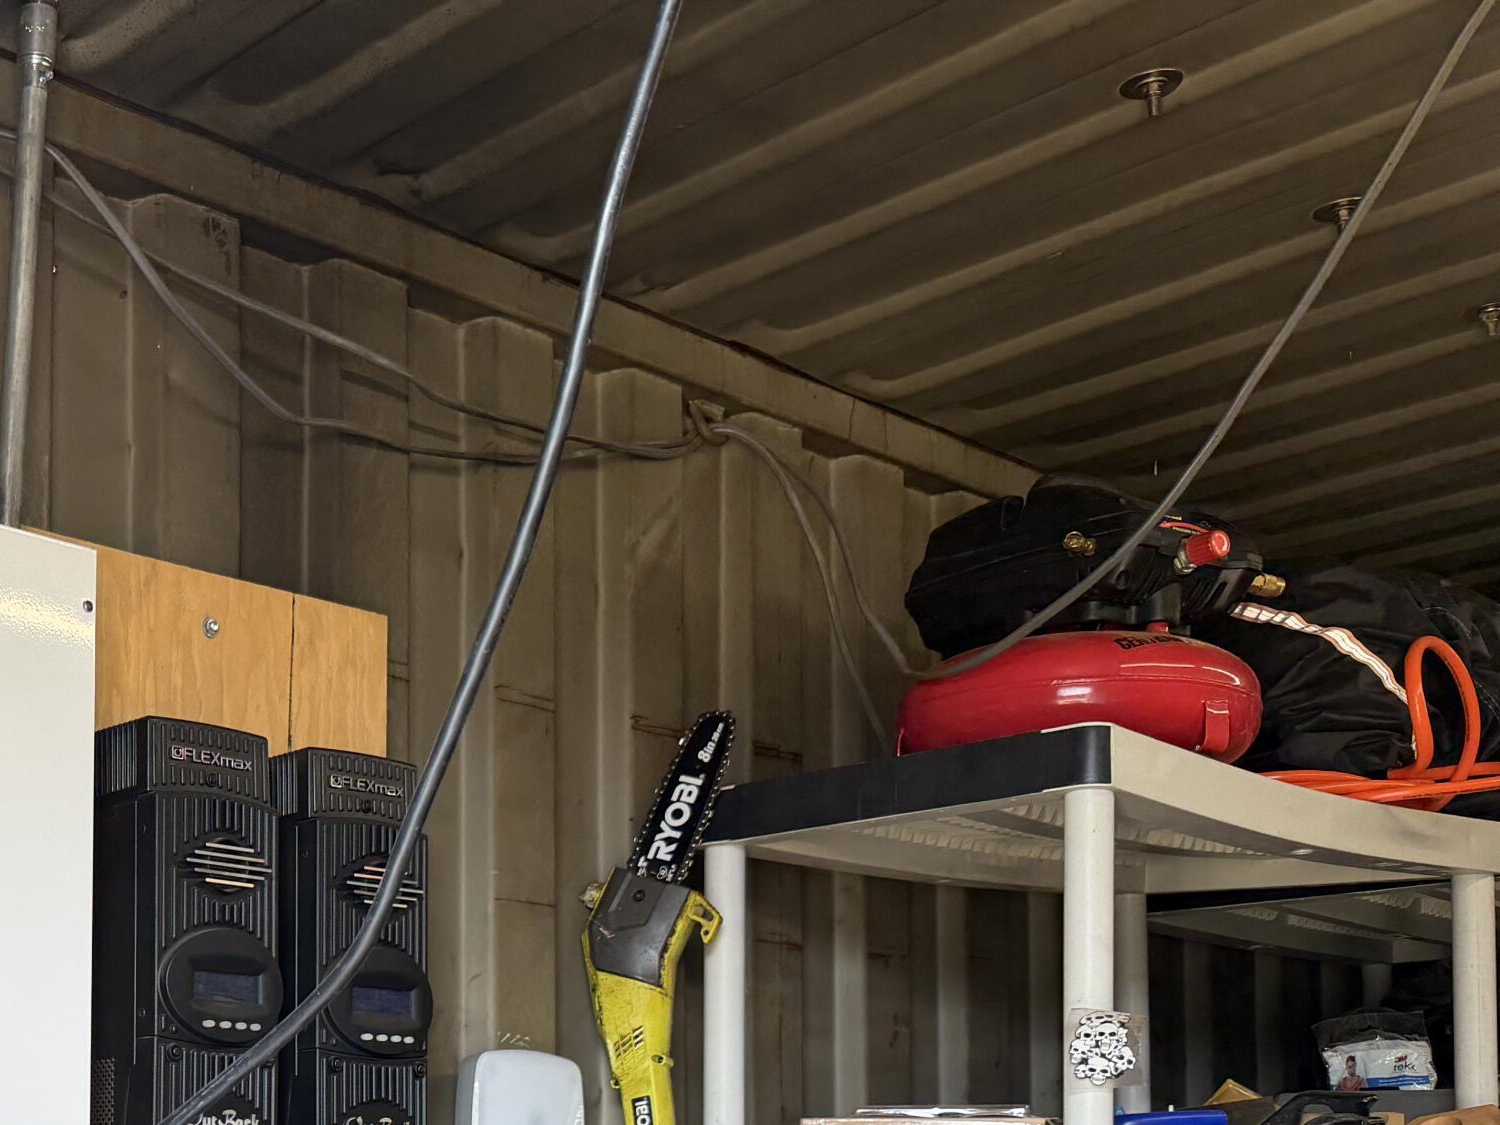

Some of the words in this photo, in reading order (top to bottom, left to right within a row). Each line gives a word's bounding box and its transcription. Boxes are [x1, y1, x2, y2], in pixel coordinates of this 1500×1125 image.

[184, 749, 252, 771] FLEXmax
[340, 776, 403, 797] FLEXmax
[647, 774, 705, 862] RYOBI
